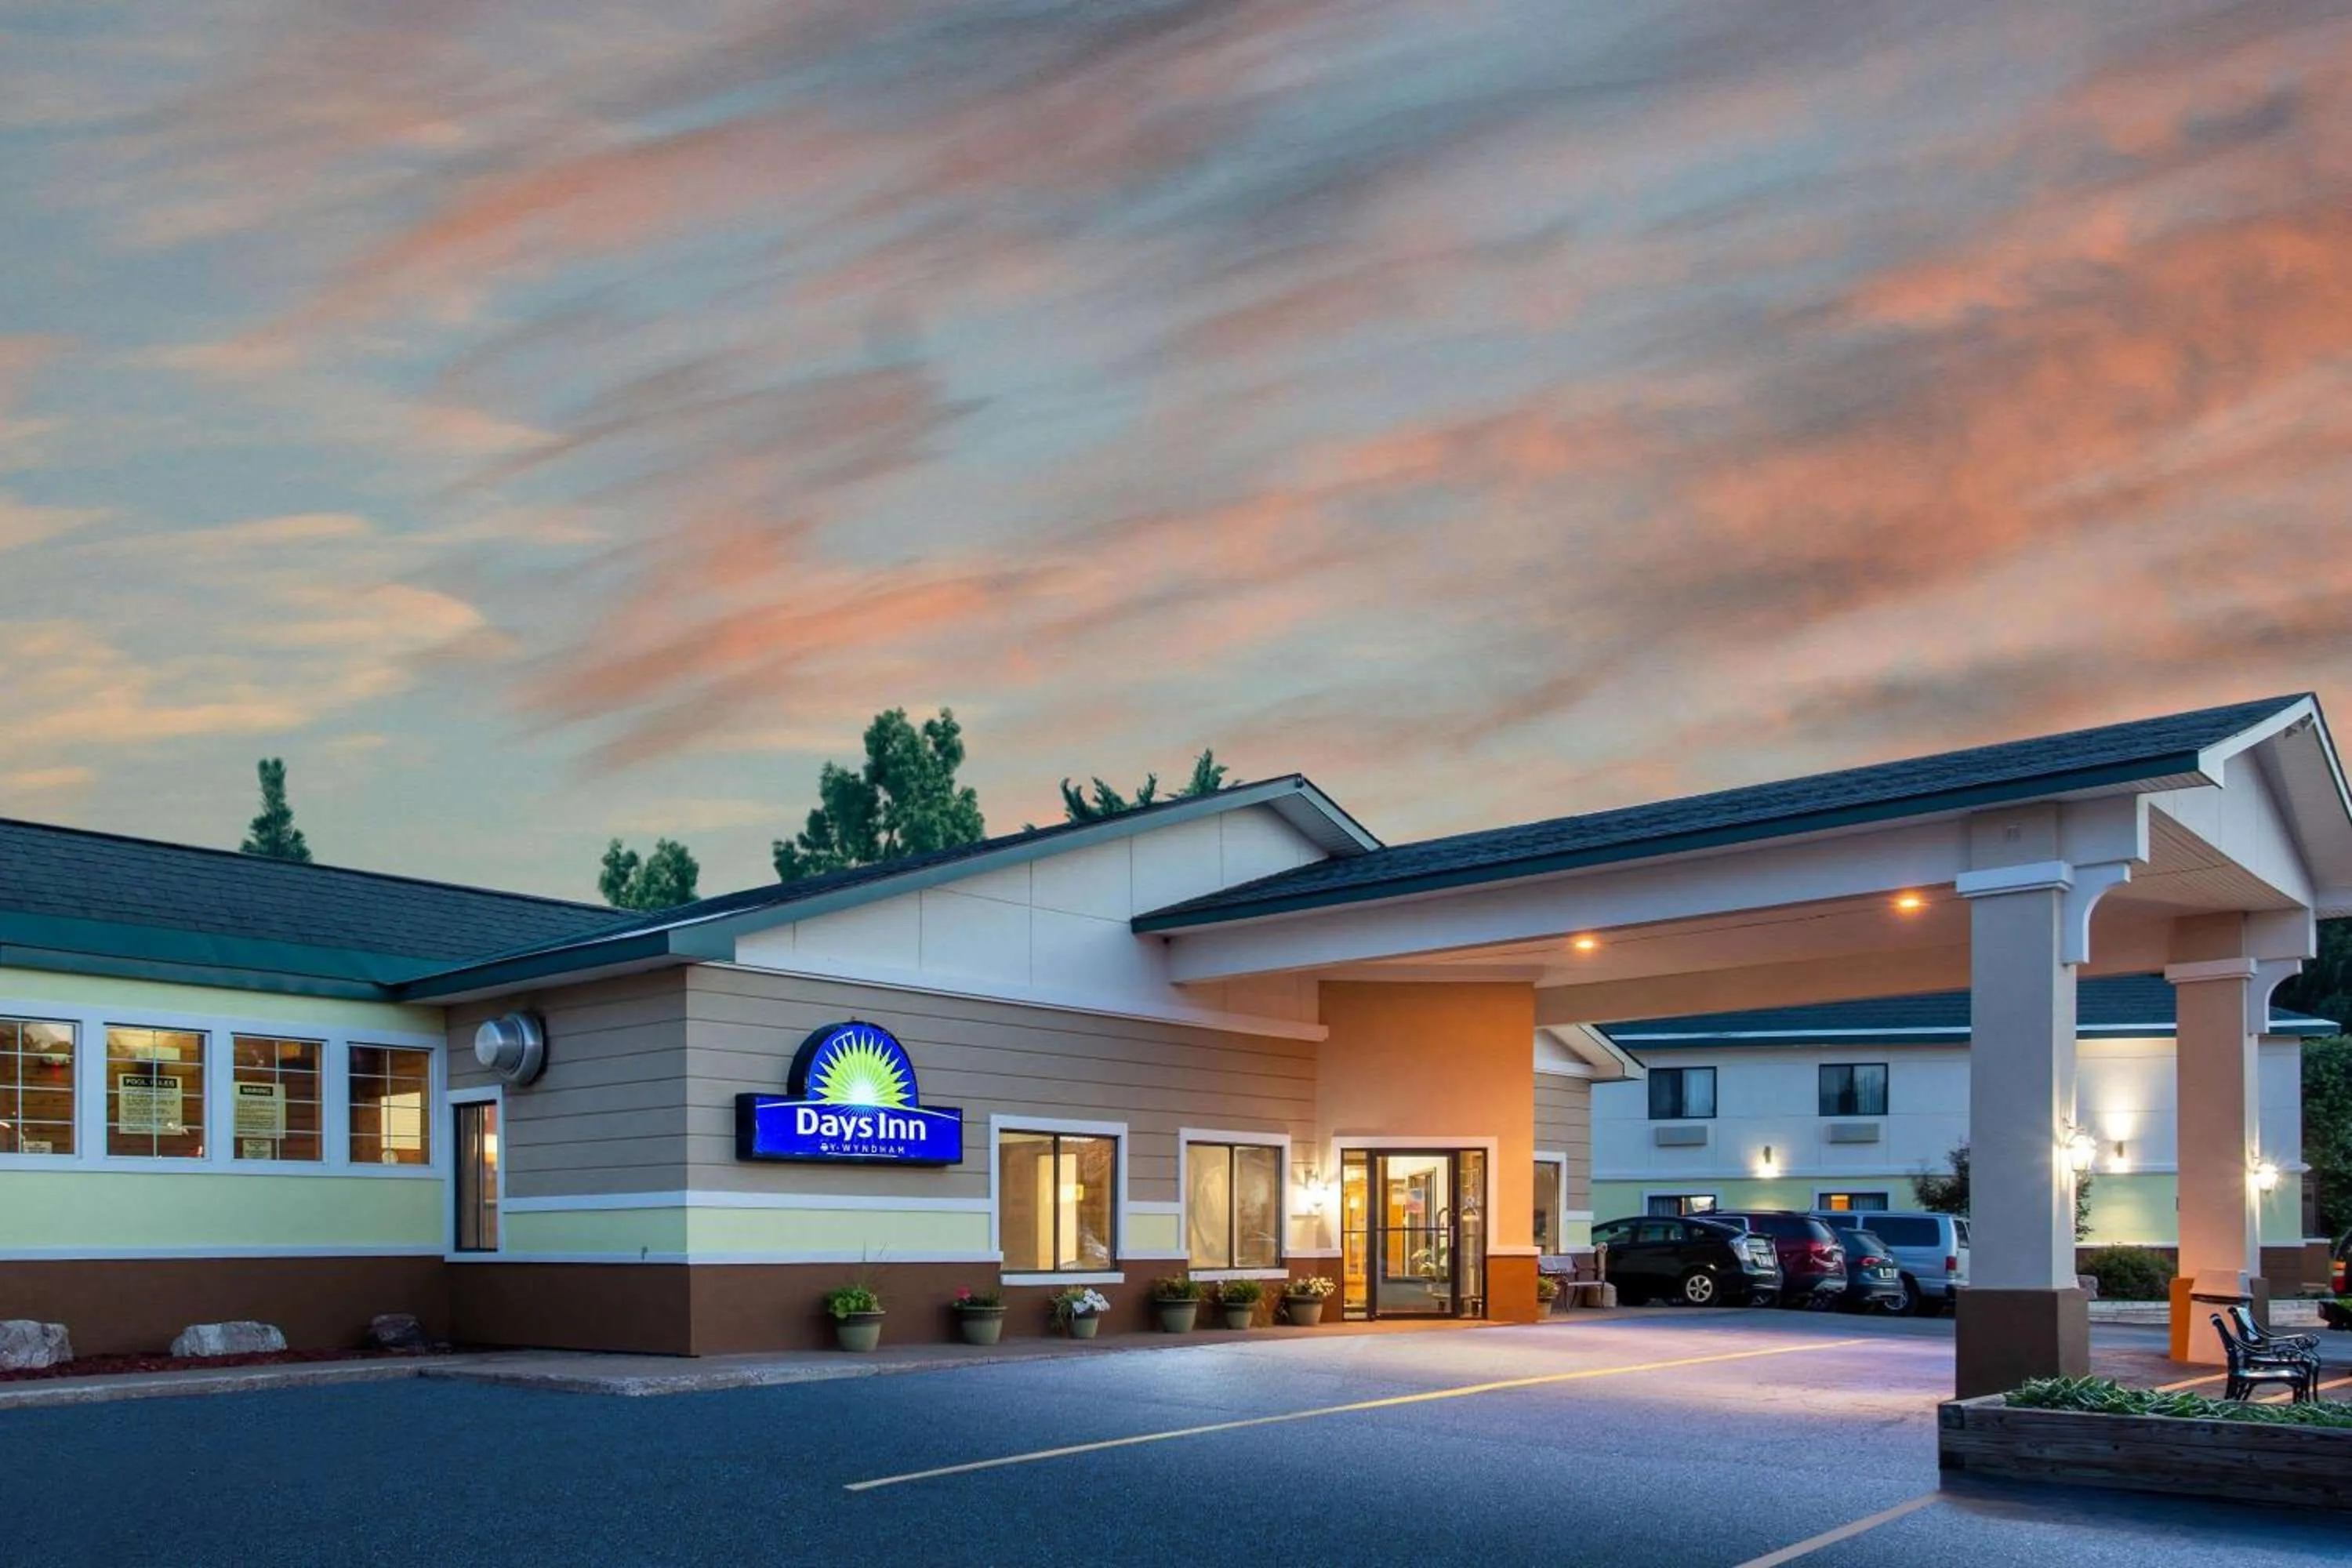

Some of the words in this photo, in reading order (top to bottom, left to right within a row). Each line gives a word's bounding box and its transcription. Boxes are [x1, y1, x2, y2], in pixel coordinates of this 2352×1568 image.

[797, 1108, 873, 1141] Days
[879, 1112, 926, 1141] Inn
[841, 1144, 905, 1154] WYNDHAM
